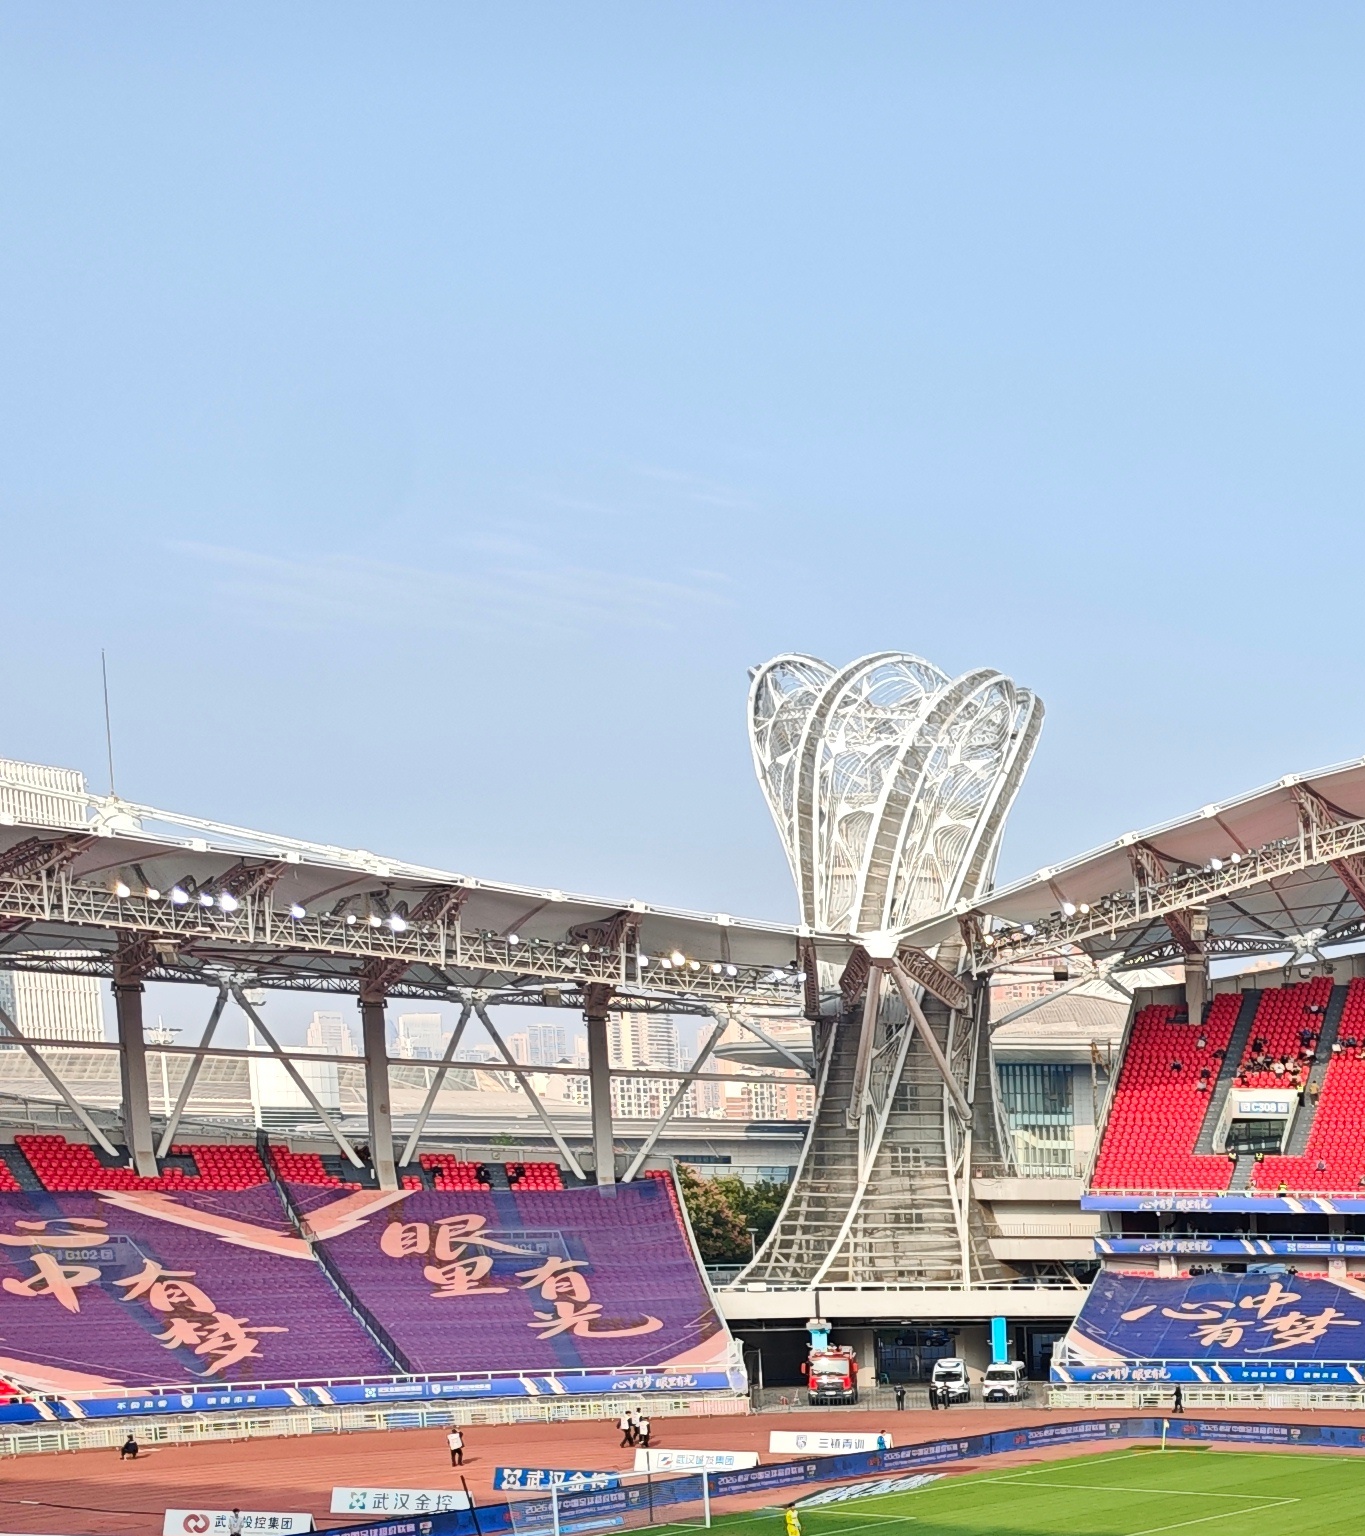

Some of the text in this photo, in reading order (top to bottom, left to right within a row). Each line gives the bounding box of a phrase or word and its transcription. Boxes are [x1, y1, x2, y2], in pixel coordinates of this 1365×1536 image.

[372, 1492, 453, 1511] 武汉金控
[214, 1515, 293, 1530] 武投控集团
